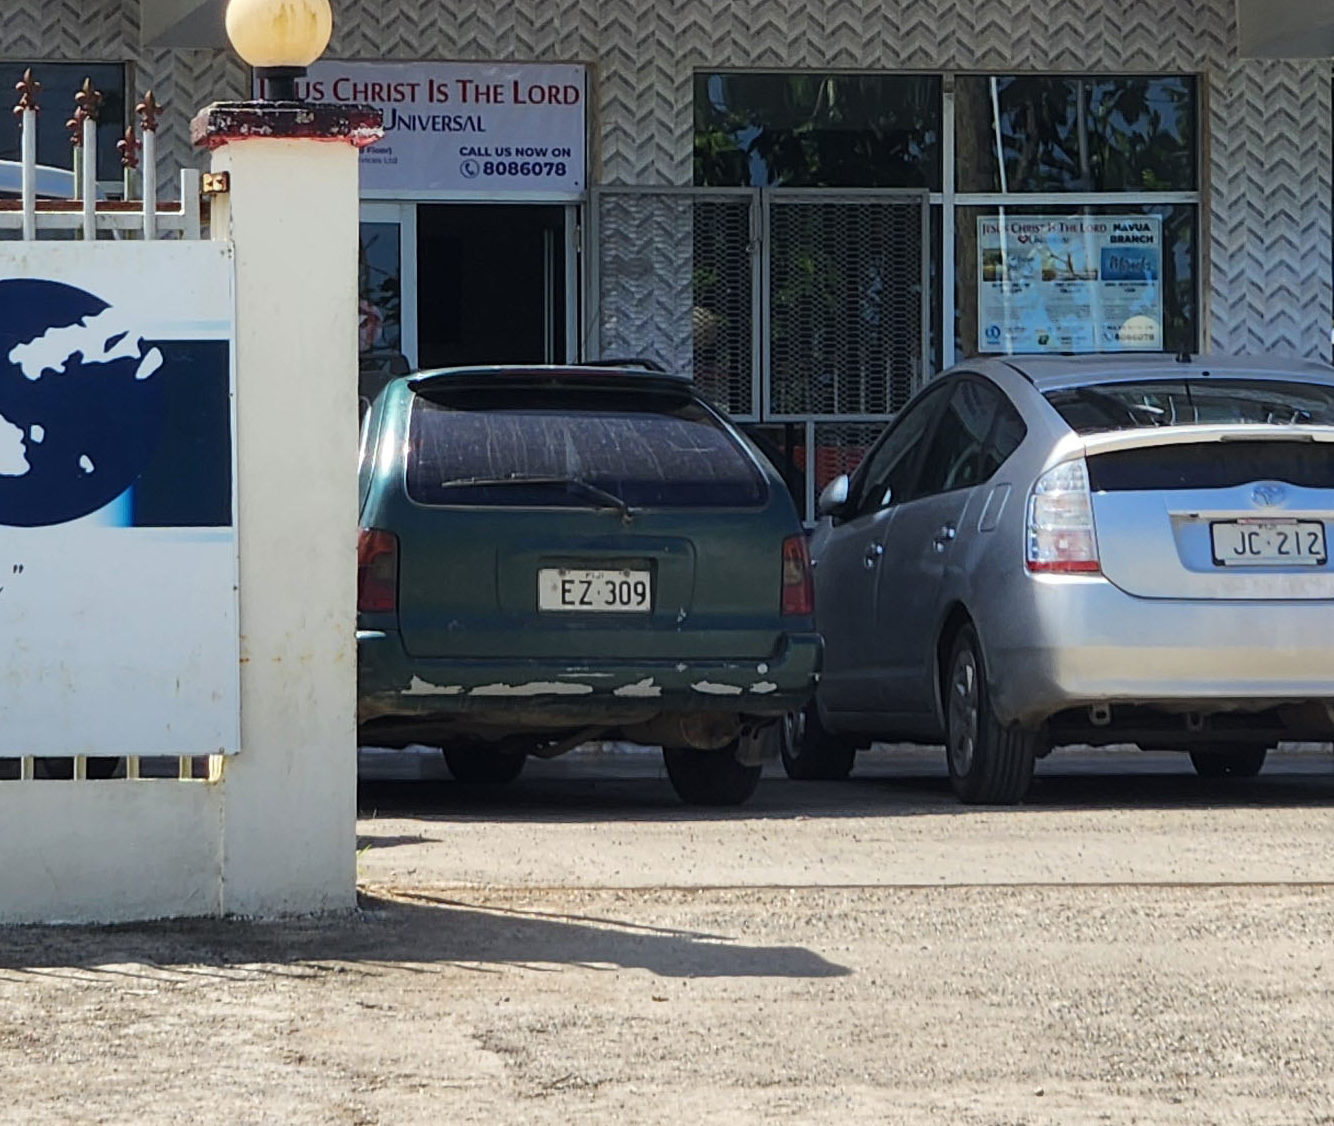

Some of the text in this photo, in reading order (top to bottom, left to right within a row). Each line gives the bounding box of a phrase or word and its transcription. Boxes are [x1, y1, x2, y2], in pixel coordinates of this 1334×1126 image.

[332, 77, 420, 103] CHRIST
[428, 78, 449, 103] IS
[454, 79, 505, 104] THE
[513, 80, 581, 106] LORD
[459, 146, 572, 159] CALL US NOW ON
[482, 161, 567, 177] 8086078
[1113, 223, 1151, 232] NAVUA
[1110, 235, 1154, 244] BRANCH
[1276, 531, 1322, 556] 212
[604, 580, 647, 606] 309
